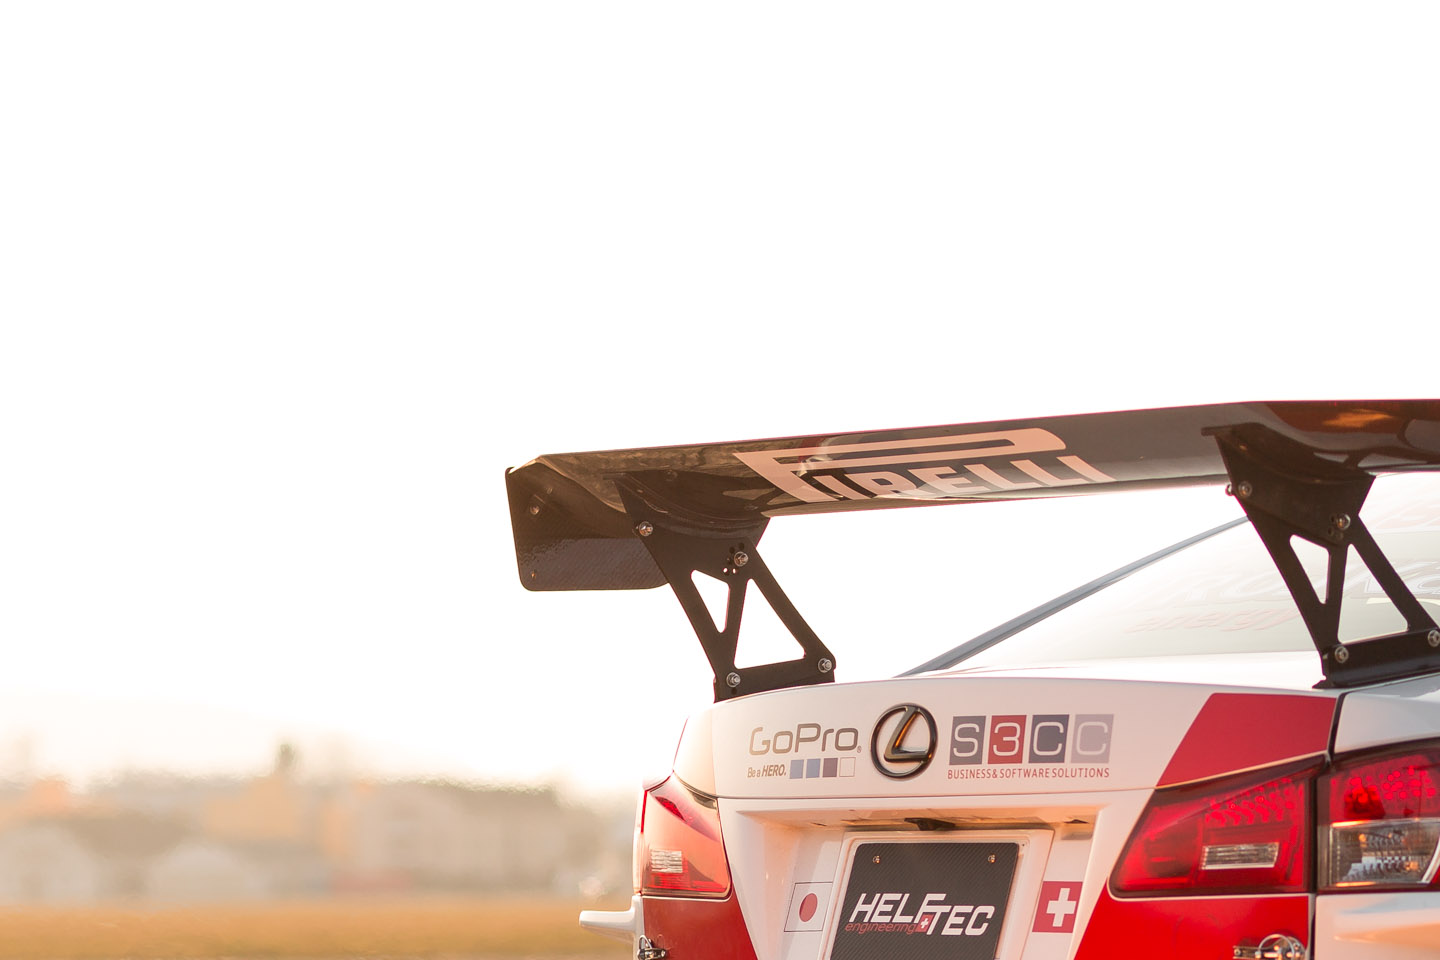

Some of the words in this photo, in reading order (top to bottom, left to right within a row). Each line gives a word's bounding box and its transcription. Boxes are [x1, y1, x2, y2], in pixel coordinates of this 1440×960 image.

[735, 427, 1118, 503] PIRELLI
[951, 717, 1112, 762] S3CC
[747, 767, 757, 778] Be
[761, 764, 787, 777] HERO.
[999, 768, 1050, 779] SOFTWARE
[1051, 767, 1110, 778] SOLUTIONS
[845, 921, 917, 935] engineering
[849, 893, 996, 936] HELFTEC
